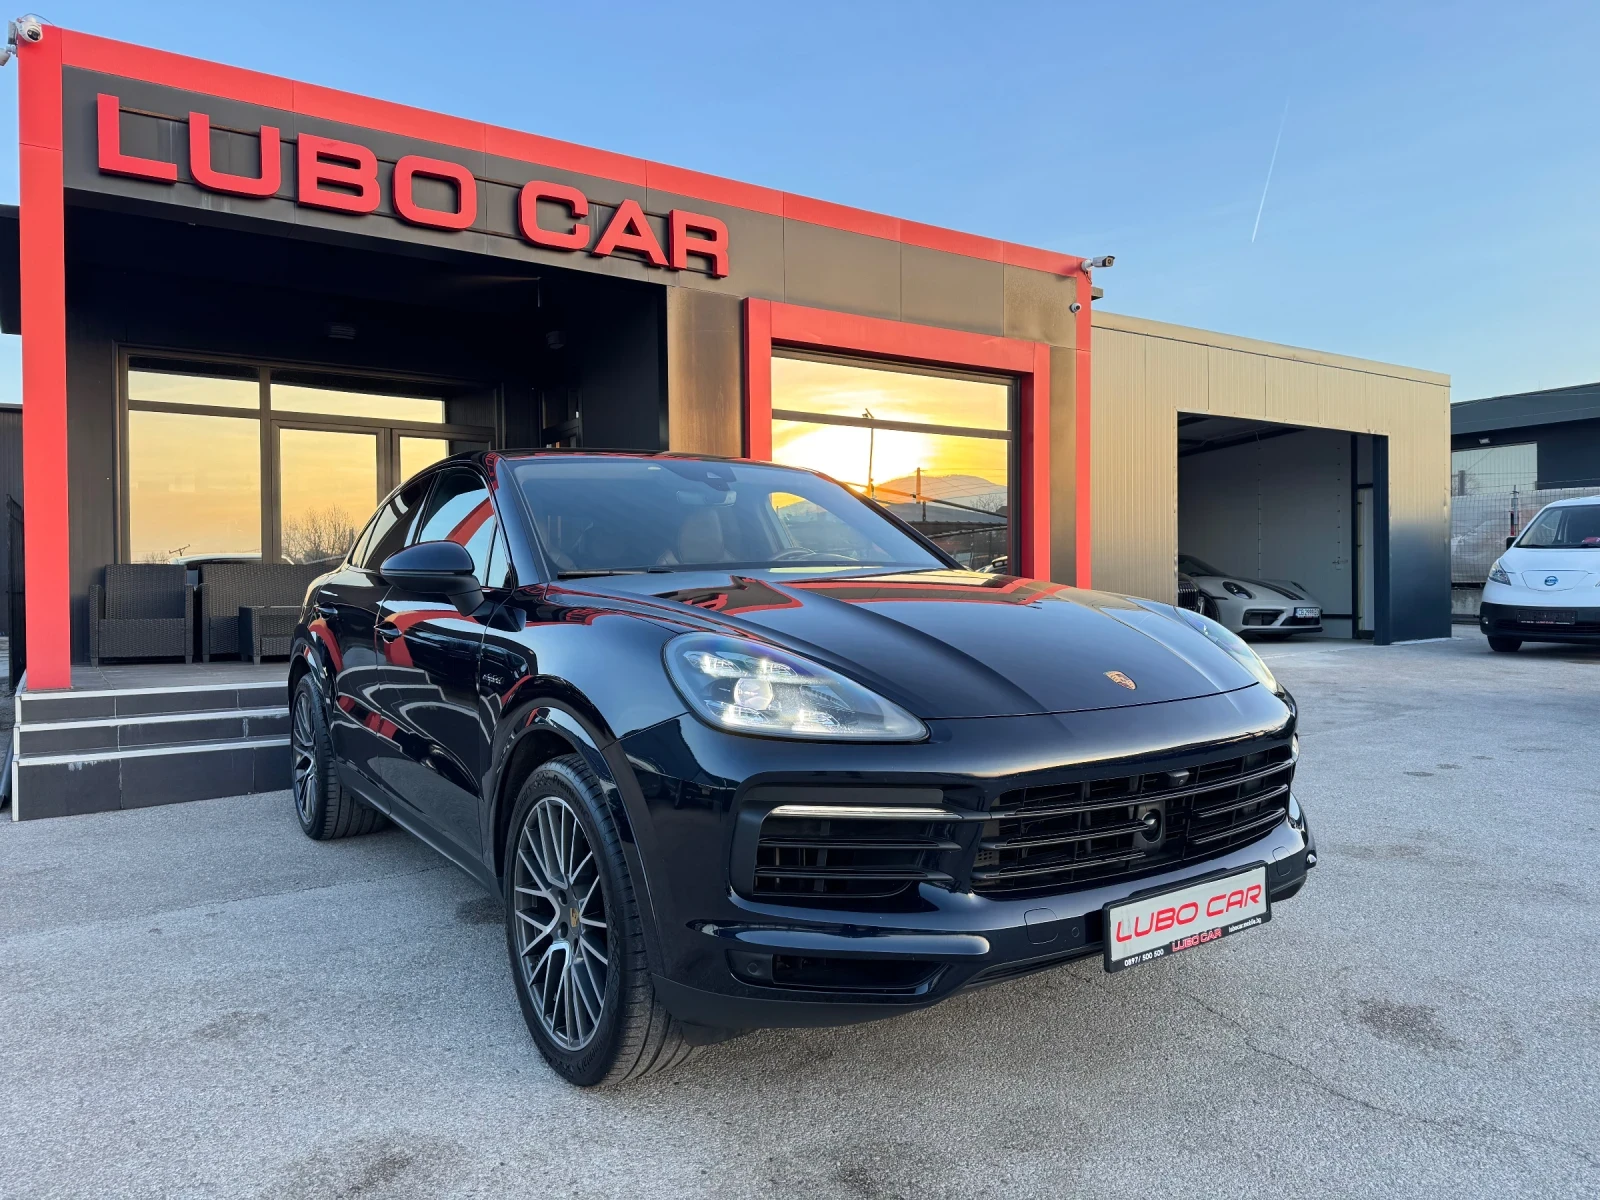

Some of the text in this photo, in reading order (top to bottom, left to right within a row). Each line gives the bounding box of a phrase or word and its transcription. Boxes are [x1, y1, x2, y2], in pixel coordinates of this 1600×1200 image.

[98, 93, 730, 278] LUBO CAR
[1115, 884, 1262, 943] LUBO CAR
[1124, 956, 1142, 967] 0897/
[1142, 952, 1153, 962] 500
[1154, 948, 1165, 958] 500
[1172, 934, 1200, 952] LUBO
[1200, 927, 1222, 943] CAR
